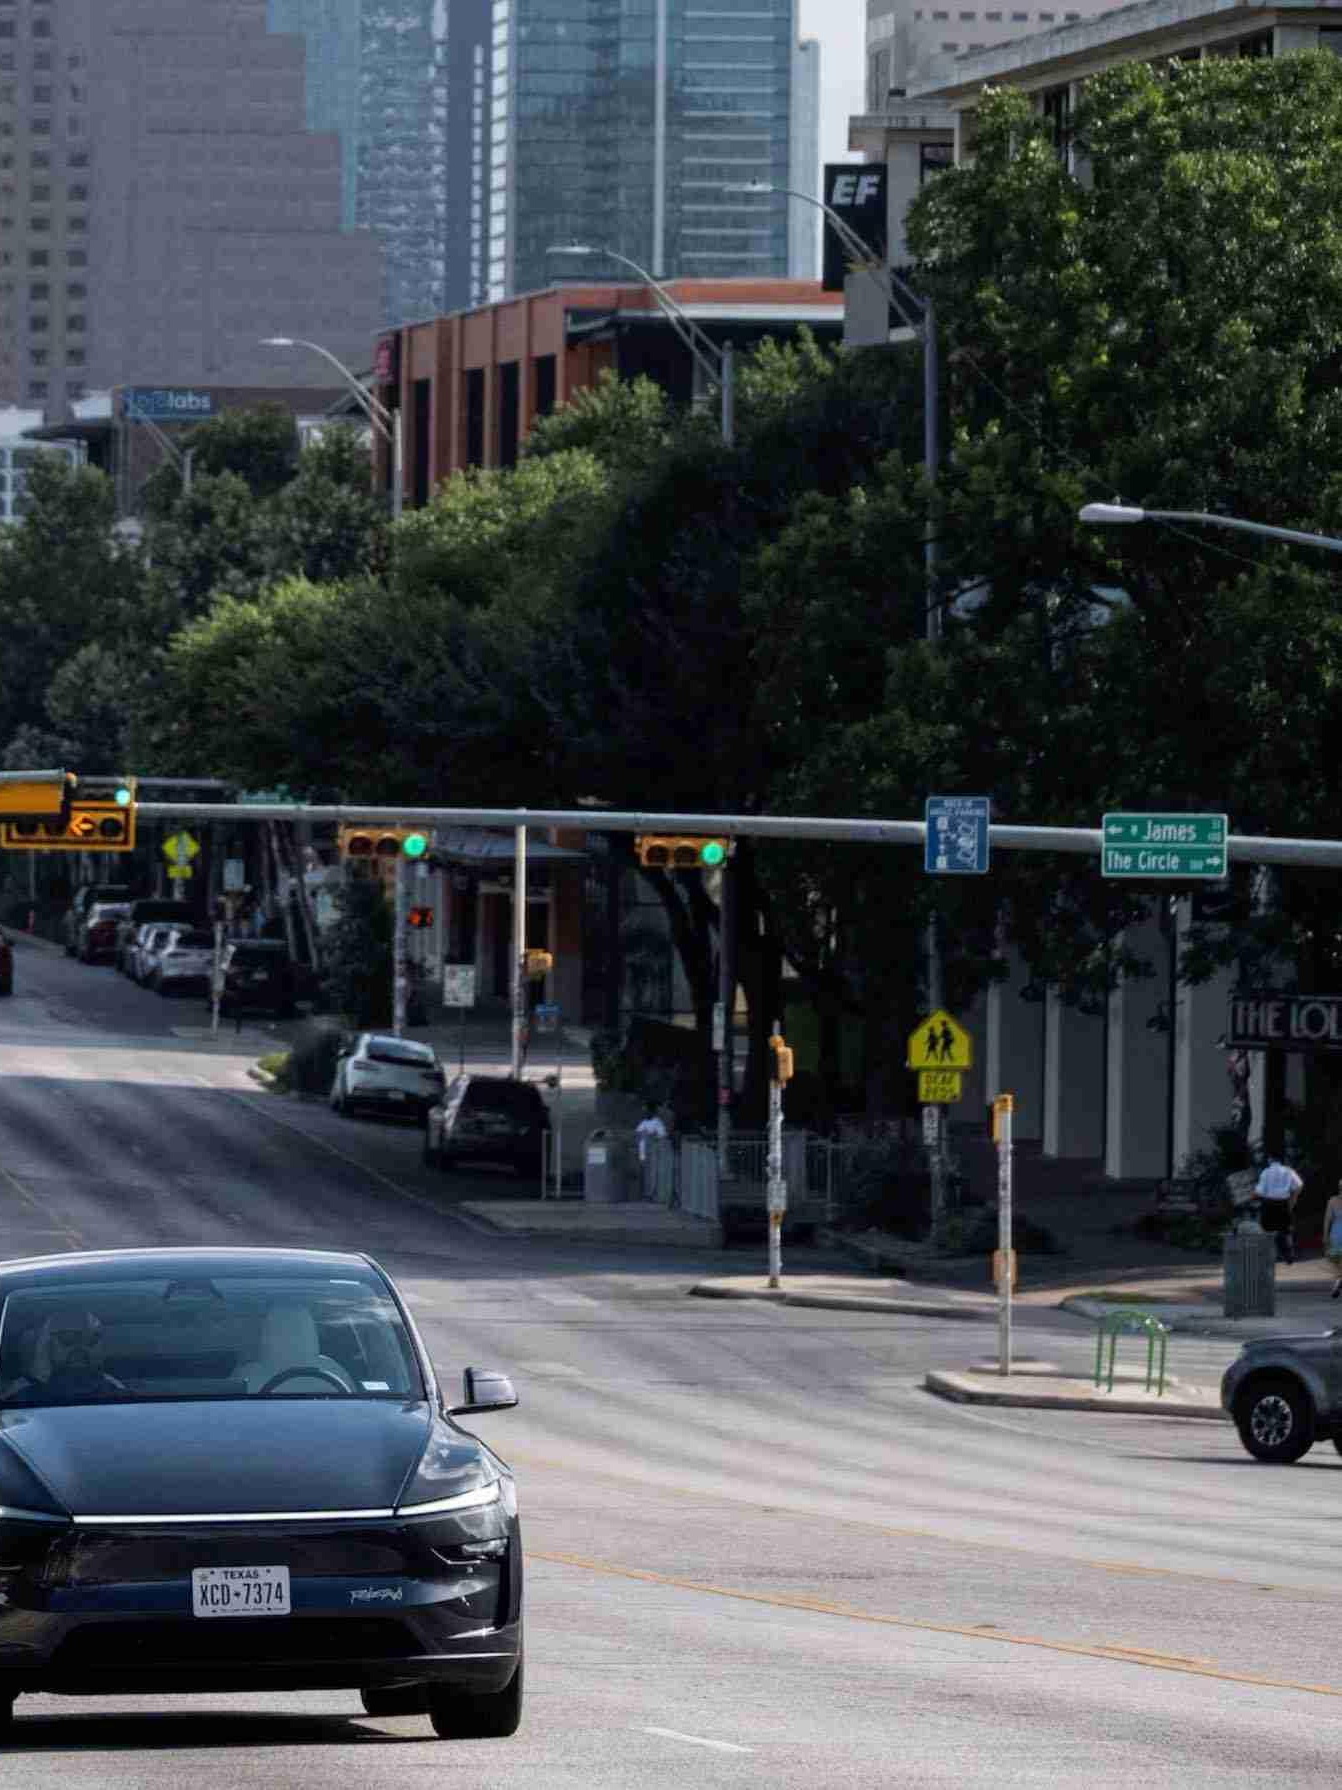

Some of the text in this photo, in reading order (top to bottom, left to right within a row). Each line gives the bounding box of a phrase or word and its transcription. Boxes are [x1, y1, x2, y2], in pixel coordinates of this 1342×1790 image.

[831, 175, 881, 206] EF
[1142, 819, 1197, 841] James
[1107, 850, 1133, 870] The
[1138, 850, 1180, 870] Circle
[1232, 1001, 1285, 1037] THE
[223, 1570, 259, 1580] TEXAS
